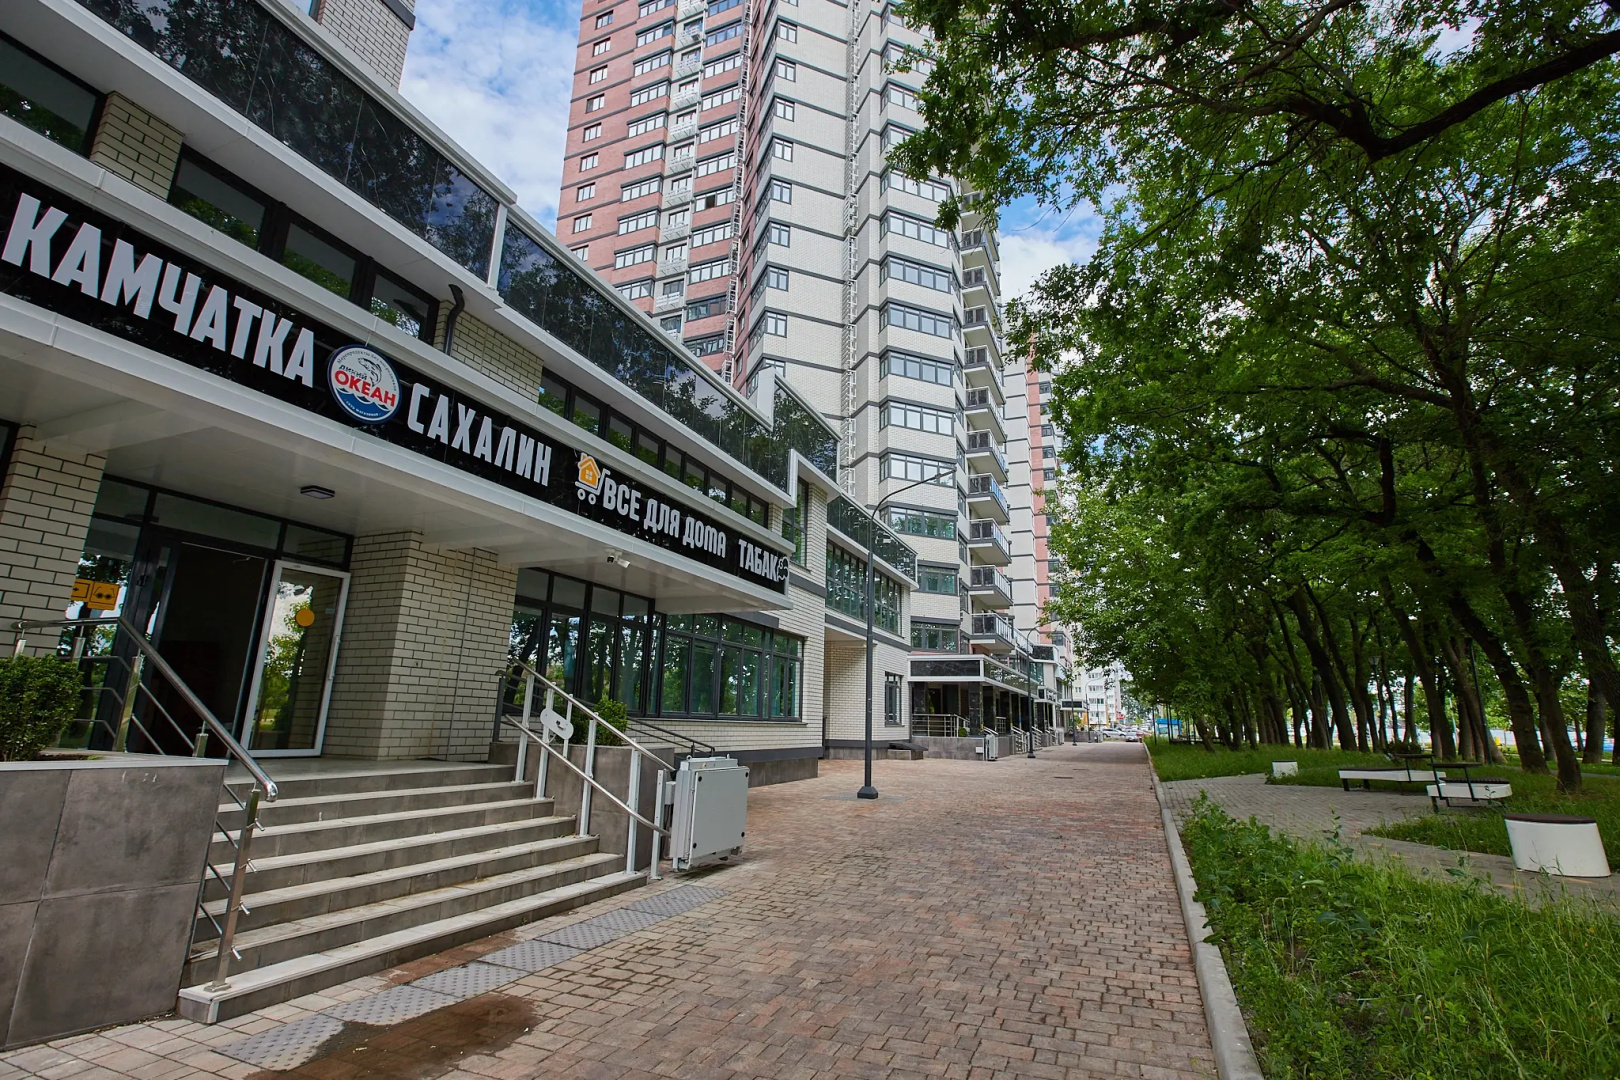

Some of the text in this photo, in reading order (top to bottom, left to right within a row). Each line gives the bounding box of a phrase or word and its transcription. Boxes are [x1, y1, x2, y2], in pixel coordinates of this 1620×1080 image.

[1, 192, 315, 389] КАМЧАТКА
[334, 370, 396, 408] ОКЕАН
[407, 382, 552, 487] САХАЛИН
[602, 477, 727, 559] ВСЕ ДЛЯ ДОМА
[738, 538, 779, 582] ТАБАК
